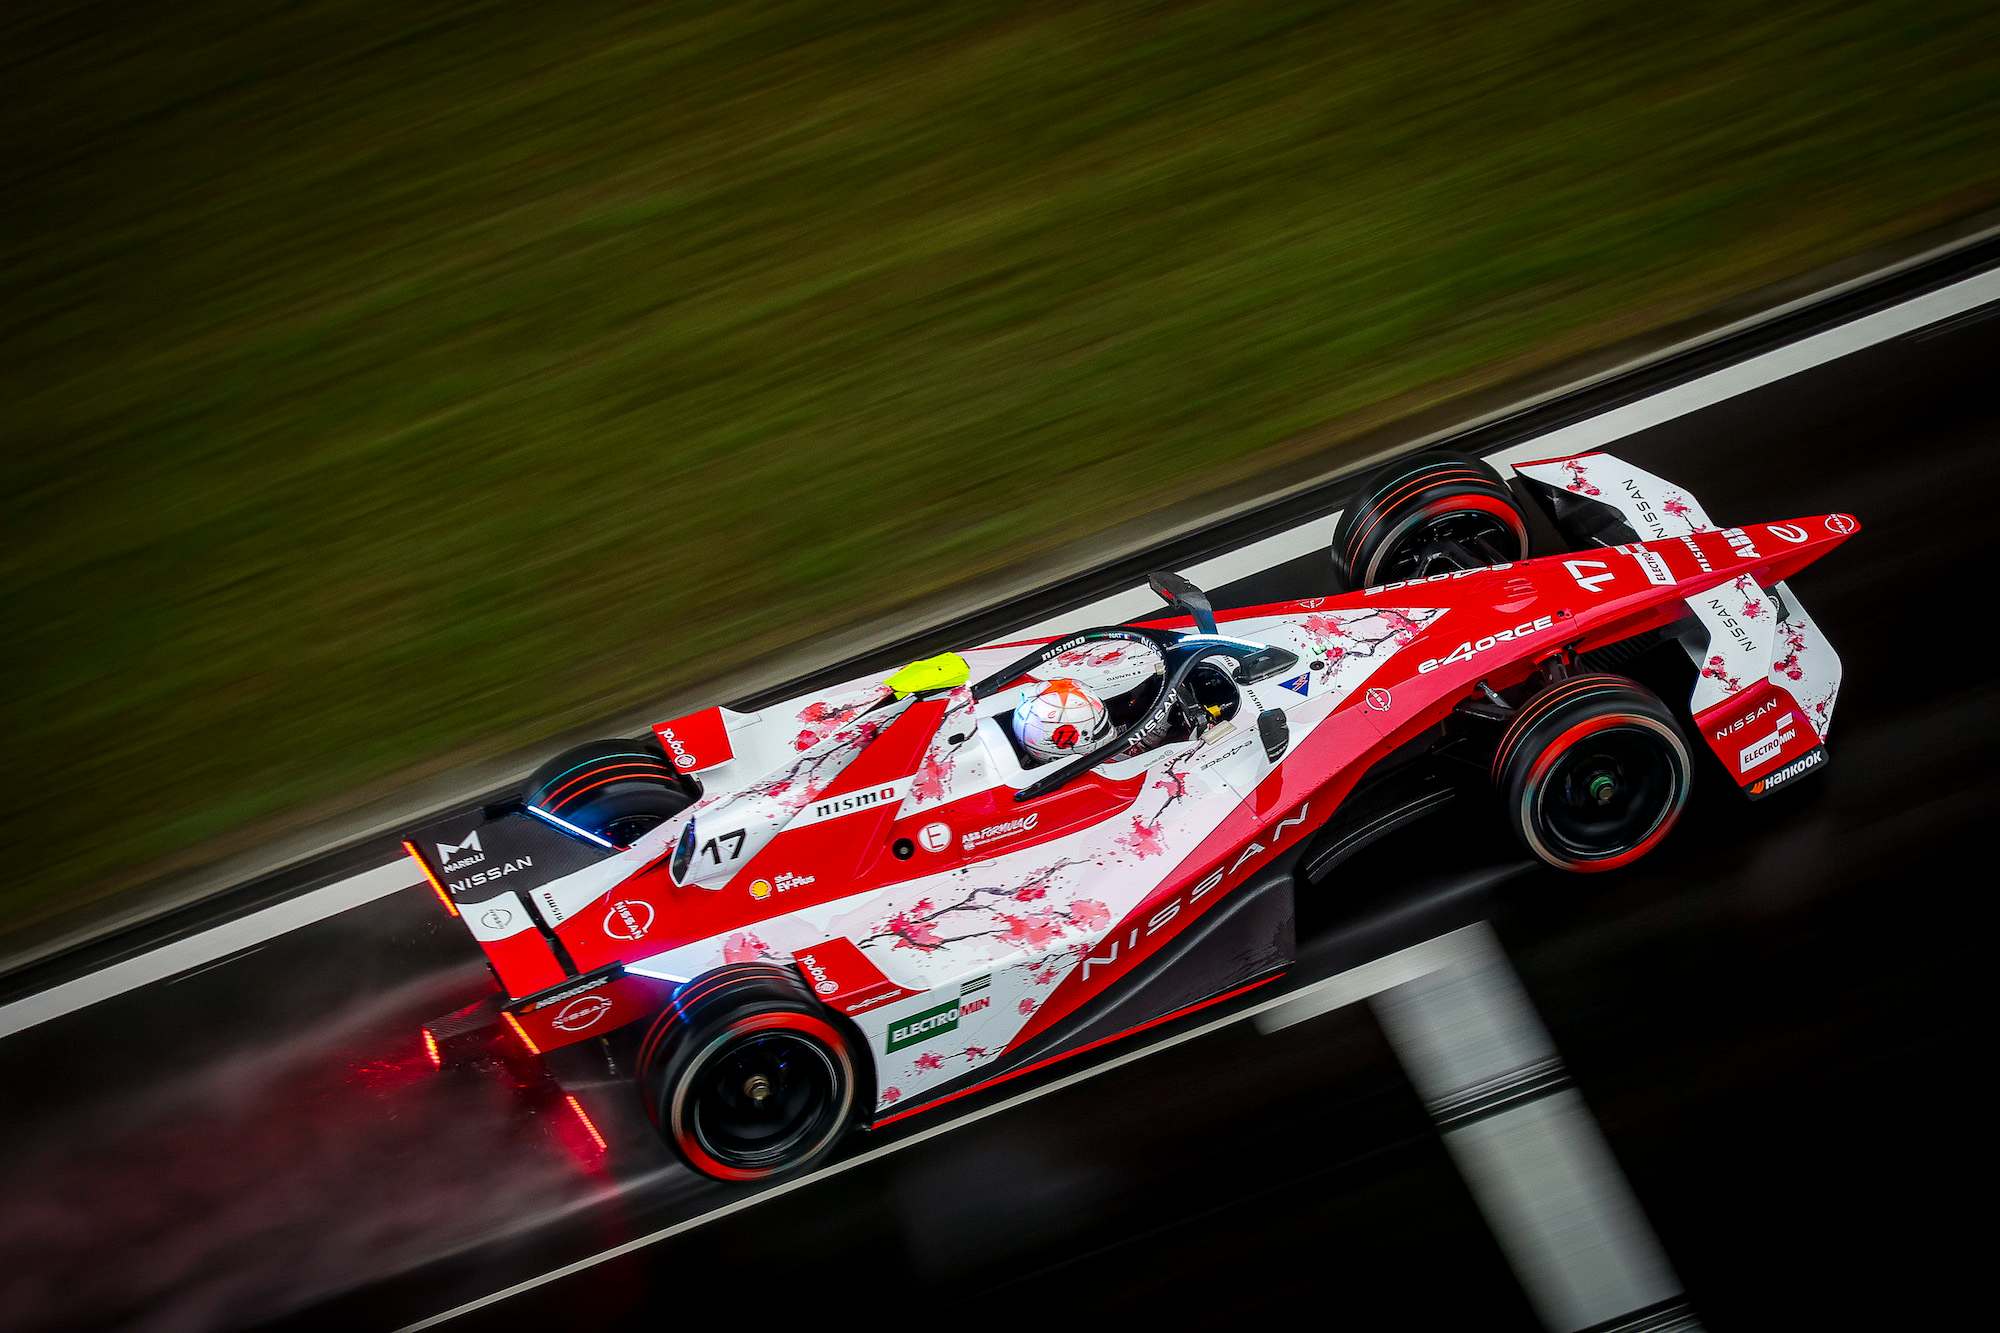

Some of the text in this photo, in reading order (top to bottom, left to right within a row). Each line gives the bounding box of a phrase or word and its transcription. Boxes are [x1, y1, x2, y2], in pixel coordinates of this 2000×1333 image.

[1622, 479, 1668, 538] NISSAN
[1680, 535, 1713, 572] nismo
[1721, 528, 1761, 558] ABB
[1562, 560, 1616, 592] 17
[1707, 599, 1757, 652] NISSAN
[1041, 636, 1086, 661] nismo
[1127, 688, 1178, 746] NISSAN
[1247, 689, 1265, 712] nism
[1716, 698, 1777, 740] NISSAN
[817, 787, 895, 817] nismo
[443, 853, 485, 873] MARELLI
[700, 828, 746, 865] 17
[449, 855, 533, 894] NISSAN
[1082, 802, 1309, 981] NISSAN
[614, 901, 645, 939] NISSAN
